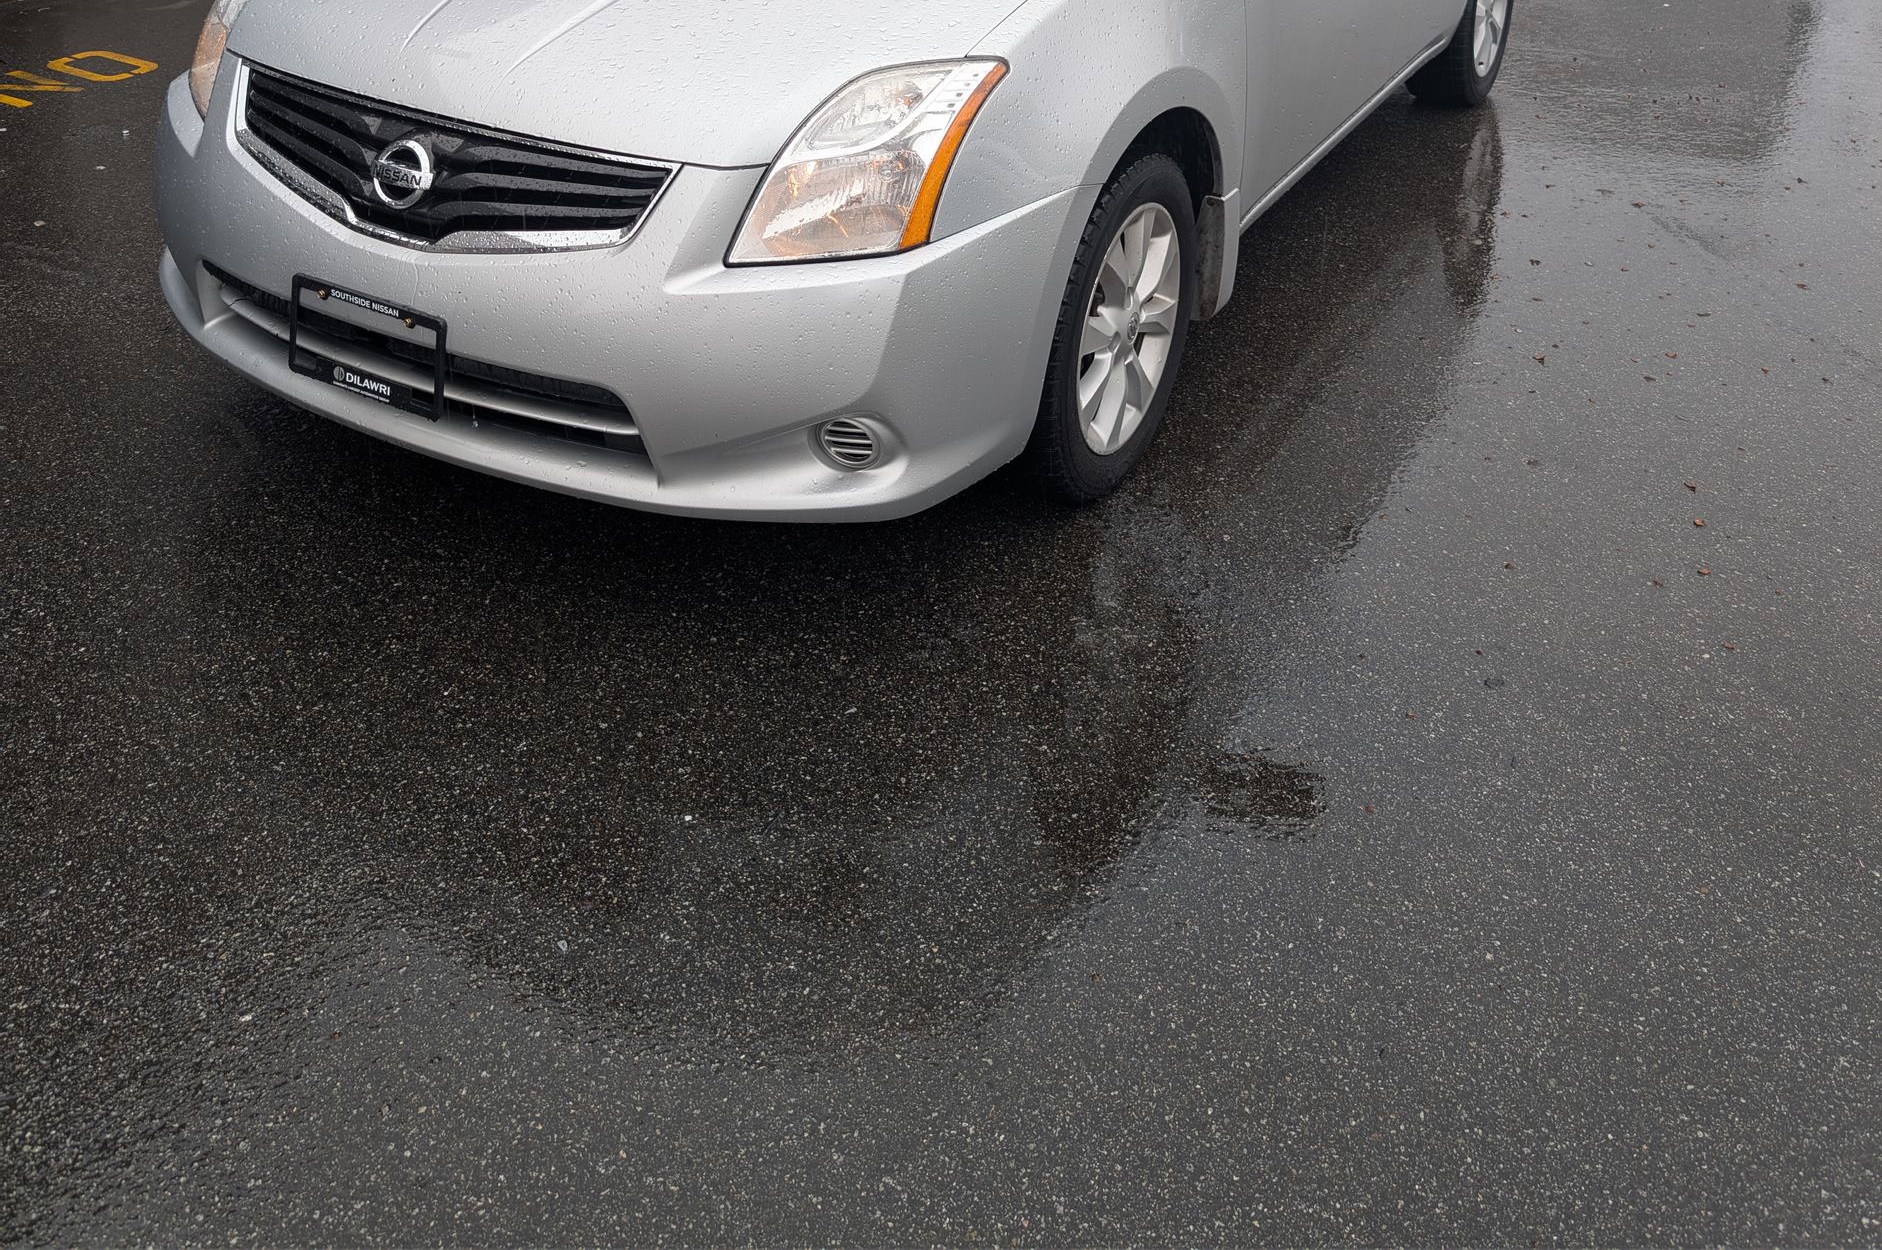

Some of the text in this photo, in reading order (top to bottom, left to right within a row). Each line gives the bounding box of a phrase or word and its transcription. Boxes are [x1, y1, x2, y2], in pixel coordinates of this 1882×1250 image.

[373, 164, 422, 186] NISSAN
[331, 289, 399, 317] SOUTHSIDE NISSAN
[346, 372, 391, 396] DILAWRI
